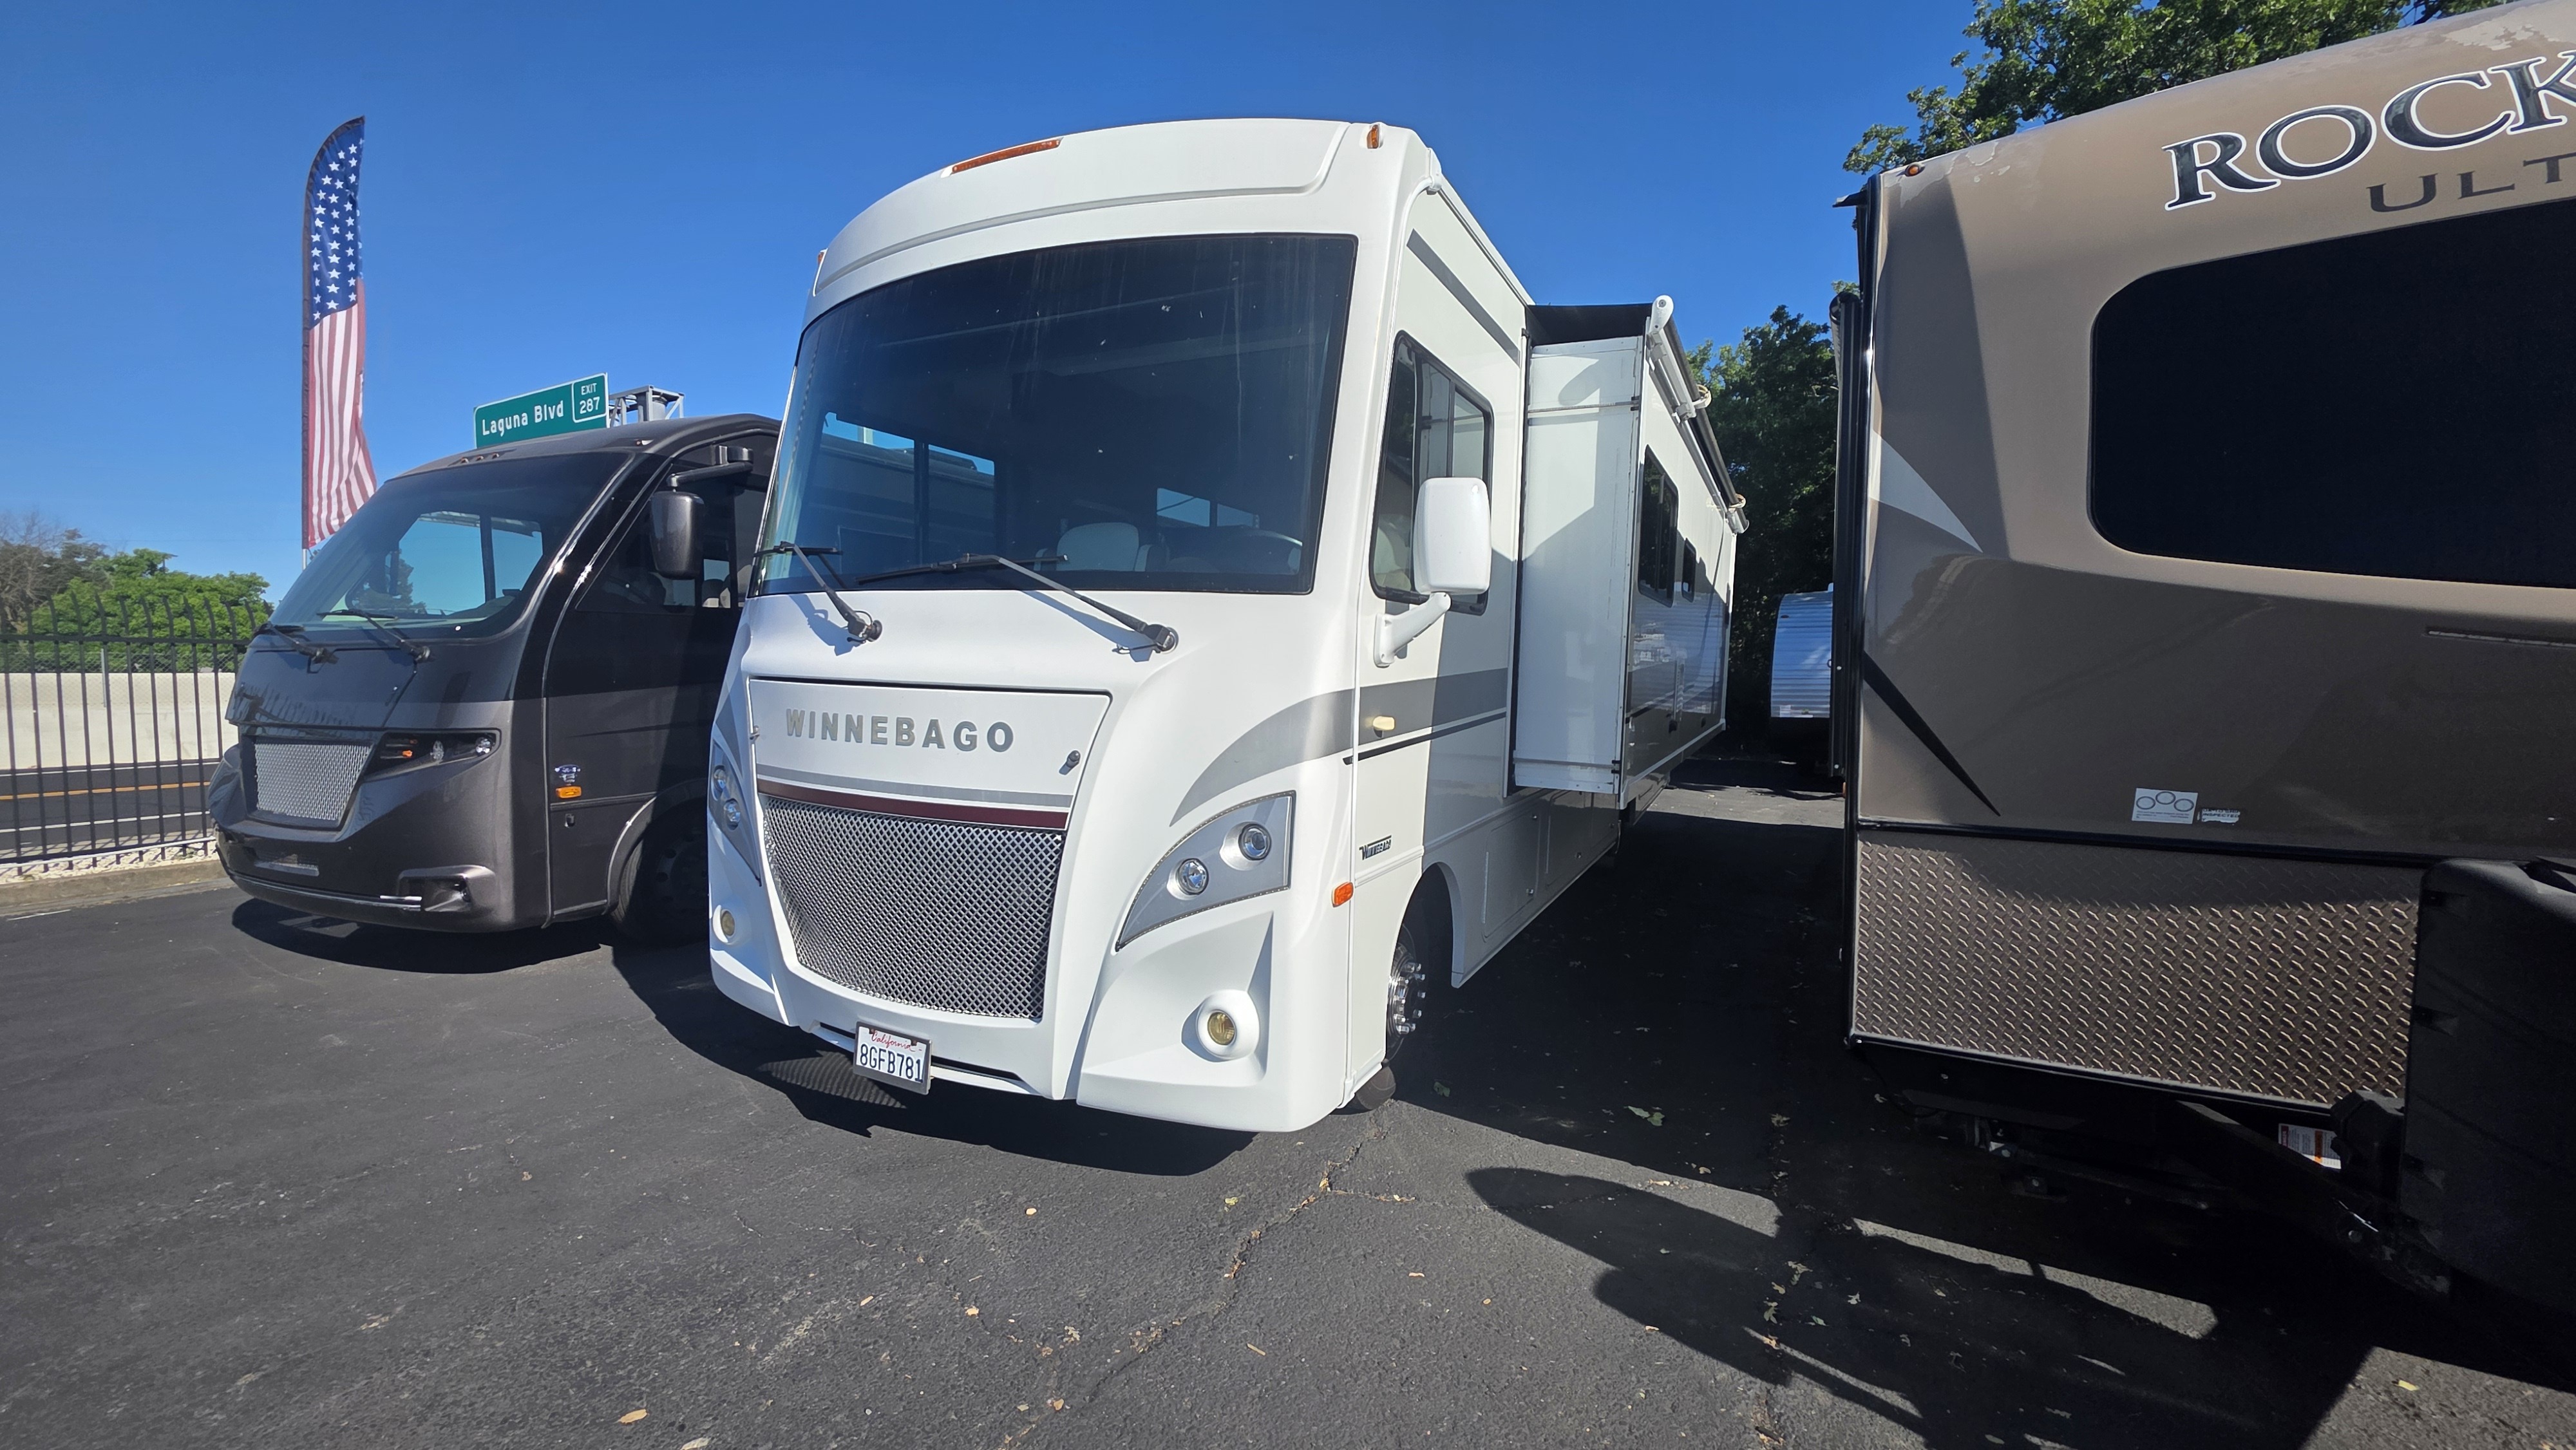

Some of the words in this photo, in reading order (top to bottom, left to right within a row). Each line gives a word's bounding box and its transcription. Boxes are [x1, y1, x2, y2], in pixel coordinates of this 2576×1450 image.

[581, 382, 597, 395] EXIT
[482, 412, 528, 437] Laguna
[534, 400, 564, 423] Blvd
[580, 396, 600, 414] 287
[786, 708, 1014, 752] WINNEBAGO
[871, 1031, 916, 1052] California
[860, 1044, 923, 1083] 8GFB781
